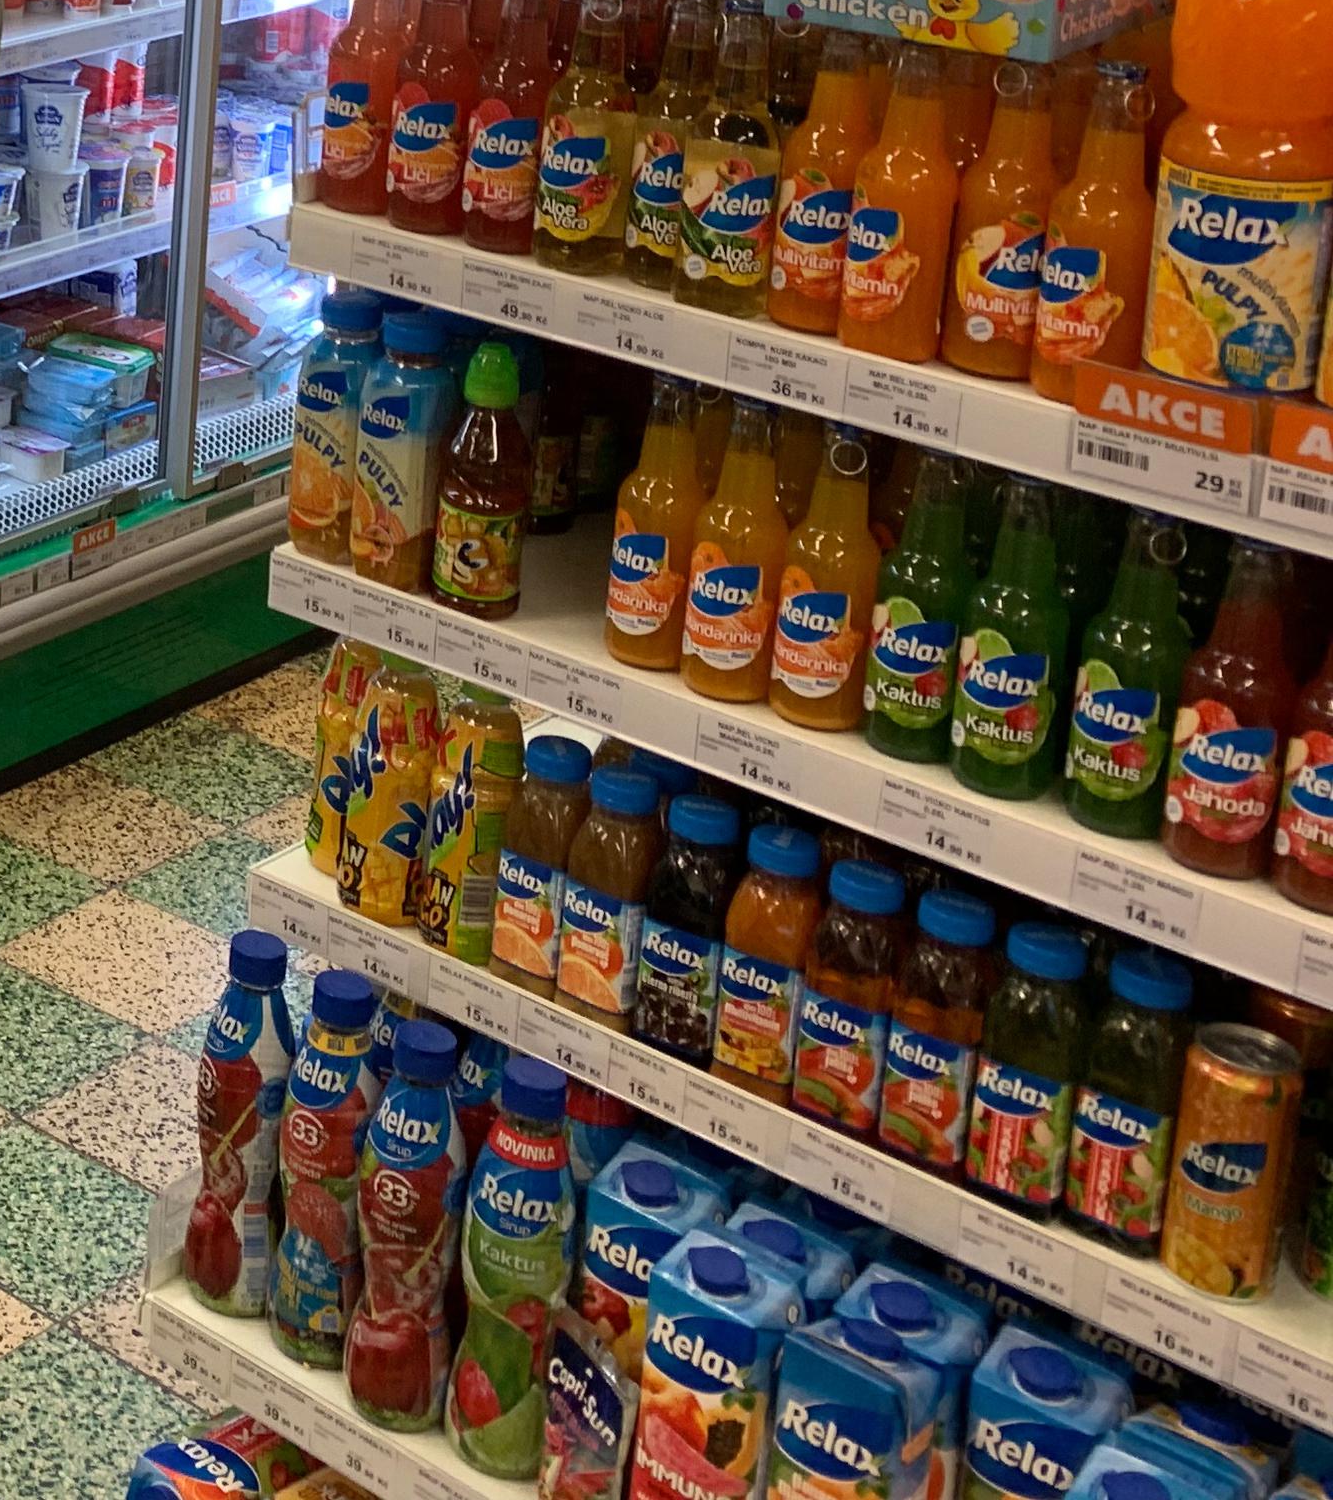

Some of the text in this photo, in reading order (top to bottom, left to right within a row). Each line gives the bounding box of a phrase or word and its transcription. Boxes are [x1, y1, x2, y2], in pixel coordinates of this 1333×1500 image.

[395, 112, 452, 141] Relax
[474, 128, 534, 158] Relax
[541, 145, 599, 178] Relax
[542, 195, 577, 219] Aloe
[709, 188, 773, 218] Relax
[789, 200, 850, 230] Relax
[552, 211, 589, 232] Vera
[639, 213, 678, 234] Aloe
[848, 223, 892, 253] elax
[1176, 198, 1291, 248] Relax
[711, 243, 754, 264] Aloe
[726, 256, 763, 276] Vera
[995, 247, 1043, 274] Rel
[1040, 262, 1093, 293] elax
[1201, 269, 1268, 321] PULPY
[298, 376, 343, 406] Relax
[361, 402, 406, 432] Relax
[1099, 382, 1226, 441] AKCE
[295, 420, 347, 471] PULPY
[357, 450, 404, 509] PULPY
[1194, 470, 1225, 495] 29
[78, 526, 113, 549] AKCE
[610, 540, 659, 575] Relax
[608, 586, 668, 614] ndarinka
[692, 570, 755, 606] Relax
[781, 598, 841, 636] Relax
[880, 628, 949, 665] Relax
[876, 677, 943, 711] Kaktus
[967, 662, 1039, 698] Relax
[965, 712, 1035, 746] Kaktus
[1078, 690, 1148, 736] Relax
[1073, 743, 1142, 785] Kaktus
[1187, 736, 1268, 774] Relax
[1181, 783, 1266, 819] Jahoda
[497, 856, 547, 896] Relax
[564, 889, 616, 930] Relax
[645, 931, 705, 972] Relax
[720, 957, 783, 997] Relax
[801, 1000, 867, 1045] Relax
[294, 1046, 349, 1095] Relax
[888, 1033, 952, 1077] Relax
[977, 1067, 1054, 1112] Relax
[291, 1118, 321, 1144] 33
[376, 1095, 441, 1146] Relax
[1081, 1095, 1152, 1142] Relax
[386, 1137, 413, 1158] Sirup
[496, 1129, 557, 1164] NOVINKA
[1184, 1141, 1260, 1188] Relax
[377, 1179, 409, 1207] 33
[478, 1175, 558, 1225] Relax
[1184, 1192, 1244, 1221] Mango
[497, 1216, 533, 1239] Sirup
[479, 1238, 546, 1272] Kaktus
[652, 1313, 748, 1391] Relax
[781, 1399, 883, 1478] Relax
[974, 1418, 1076, 1492] Relax
[177, 1435, 244, 1494] Relax
